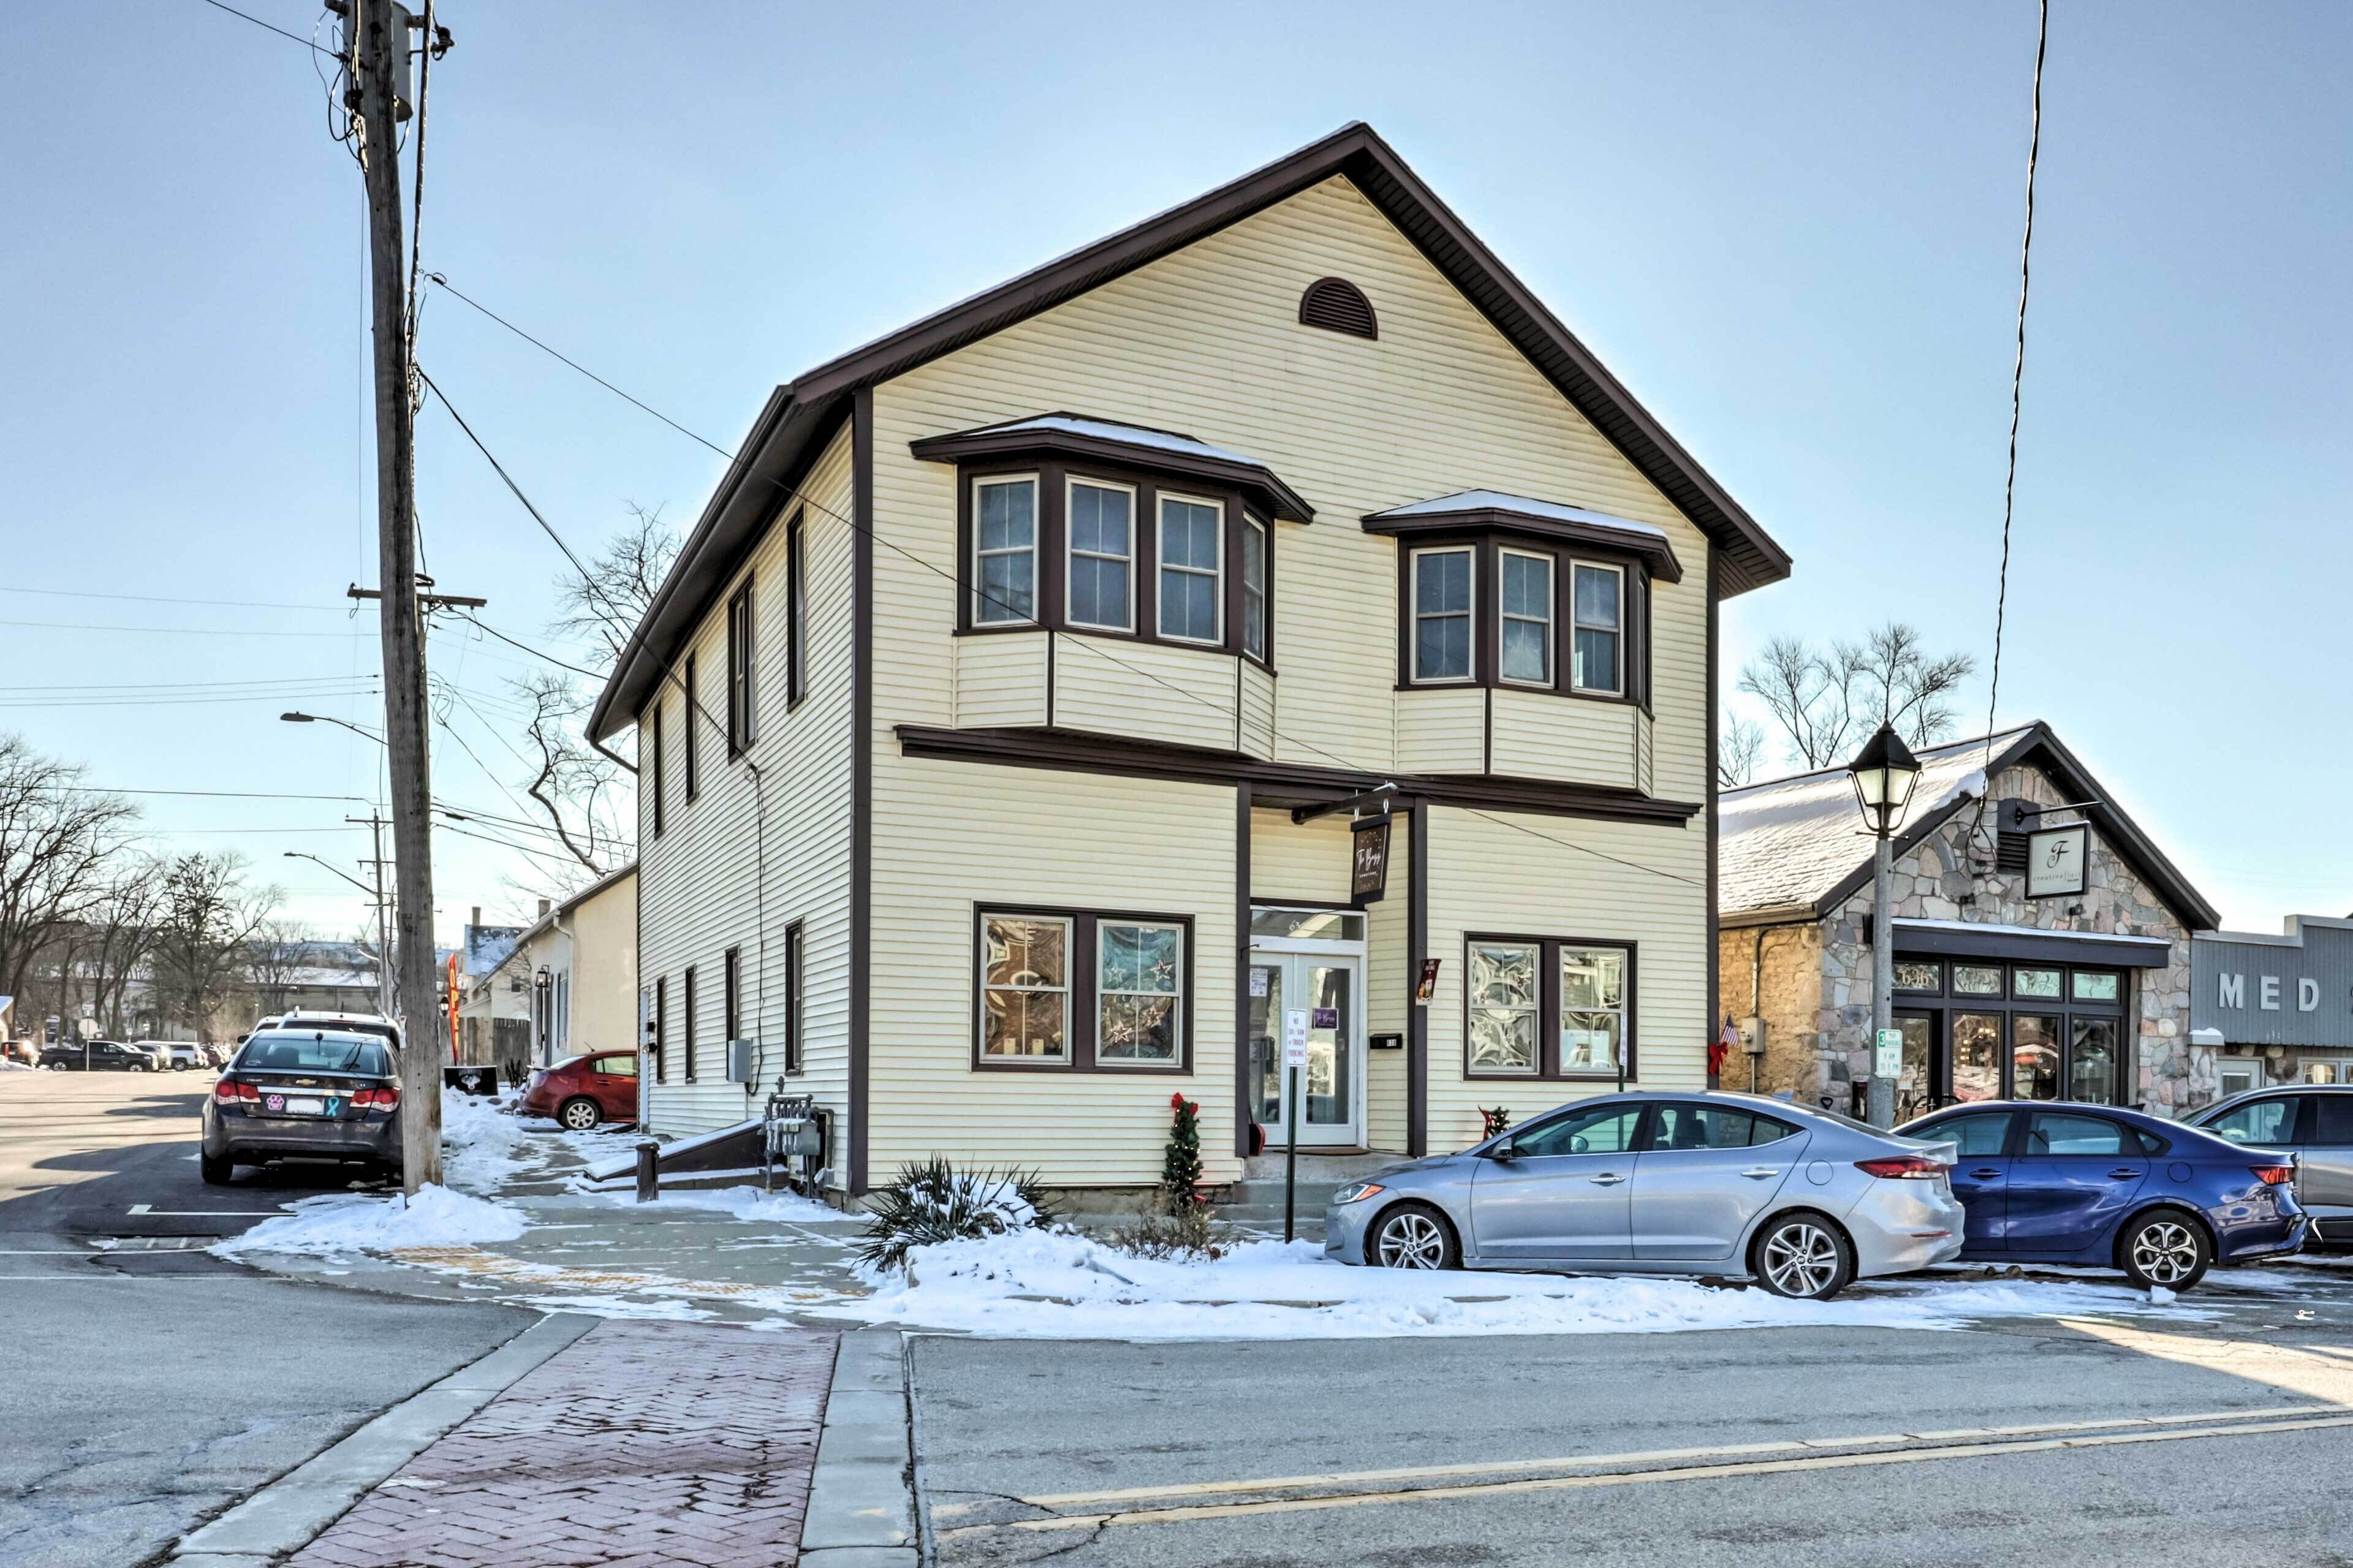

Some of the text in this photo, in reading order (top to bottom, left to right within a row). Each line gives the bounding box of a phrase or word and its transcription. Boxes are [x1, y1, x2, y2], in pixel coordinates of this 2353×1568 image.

[2047, 840, 2069, 868] F
[1901, 969, 1929, 986] 636
[2218, 972, 2319, 1012] MED
[1879, 1032, 1885, 1045] 3
